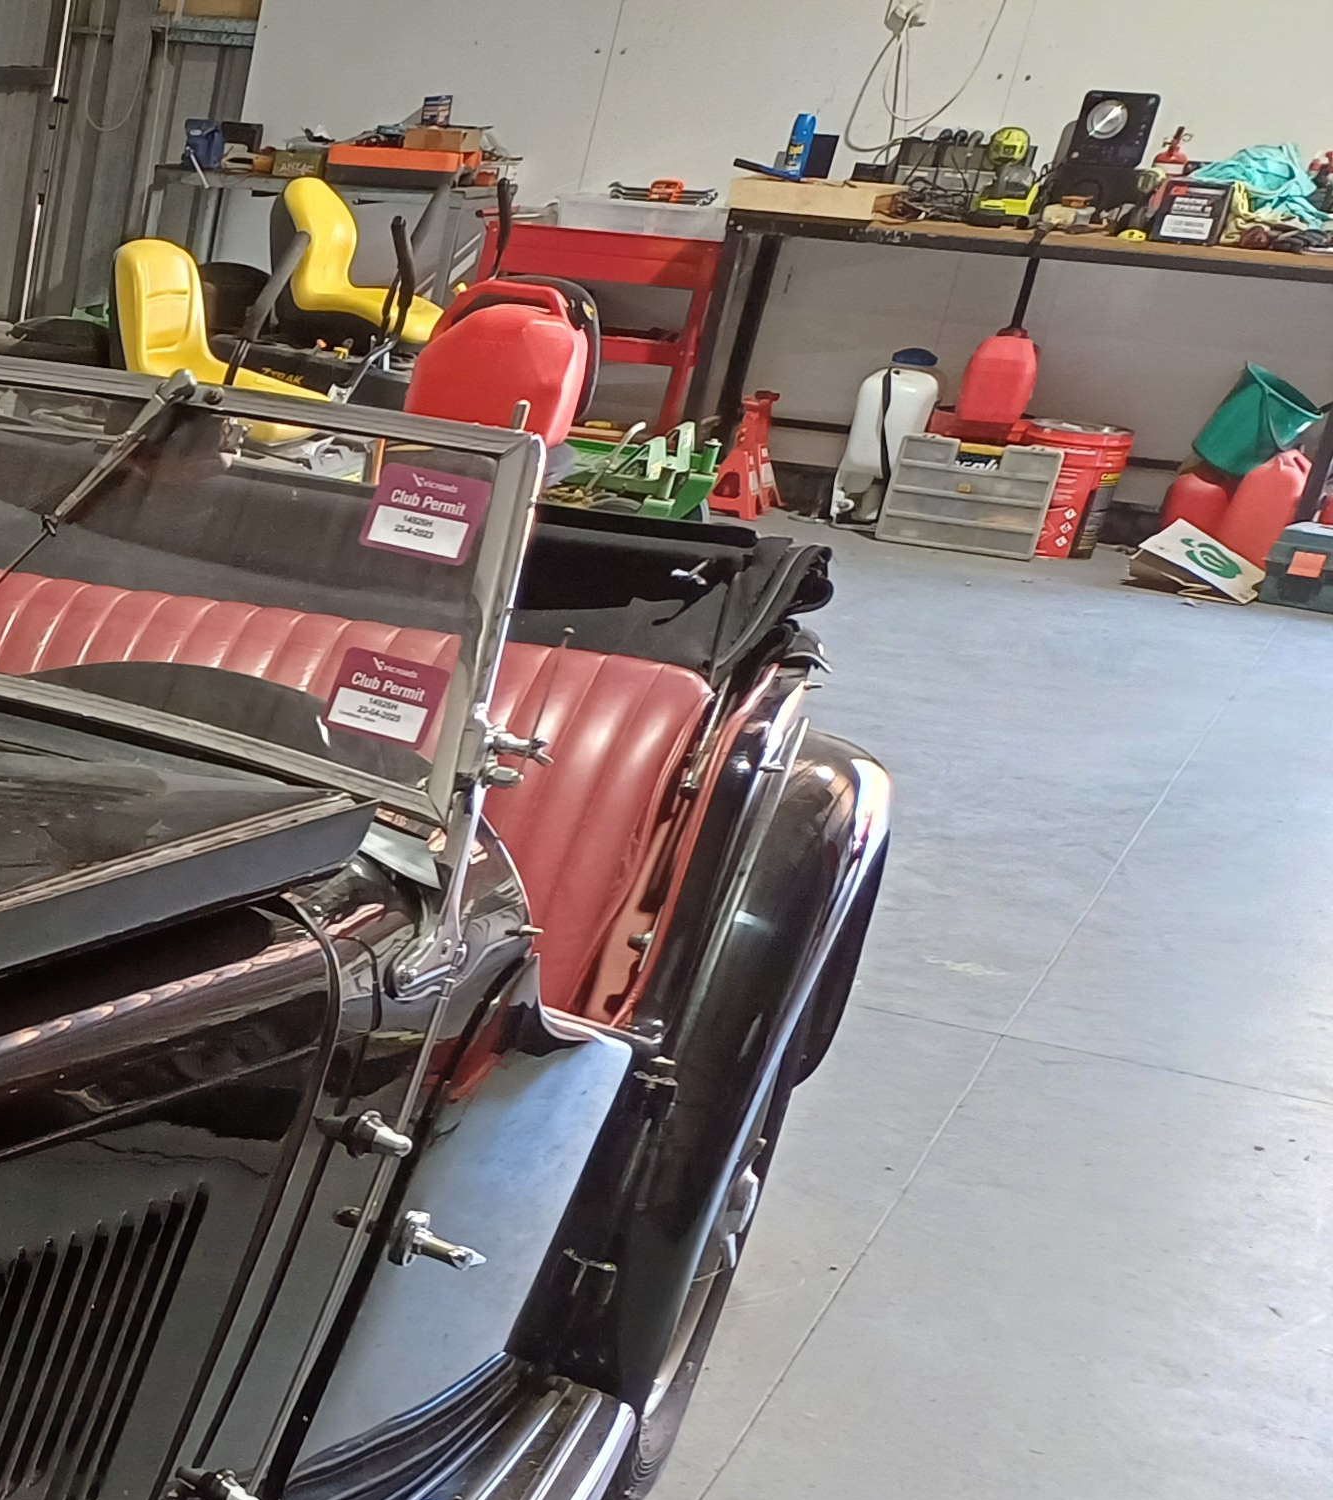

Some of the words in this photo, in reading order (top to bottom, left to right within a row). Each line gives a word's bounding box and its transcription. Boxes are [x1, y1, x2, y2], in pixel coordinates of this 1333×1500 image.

[391, 489, 421, 507] Club
[421, 495, 467, 517] Permit
[351, 671, 381, 690] Club
[381, 679, 426, 702] Permit
